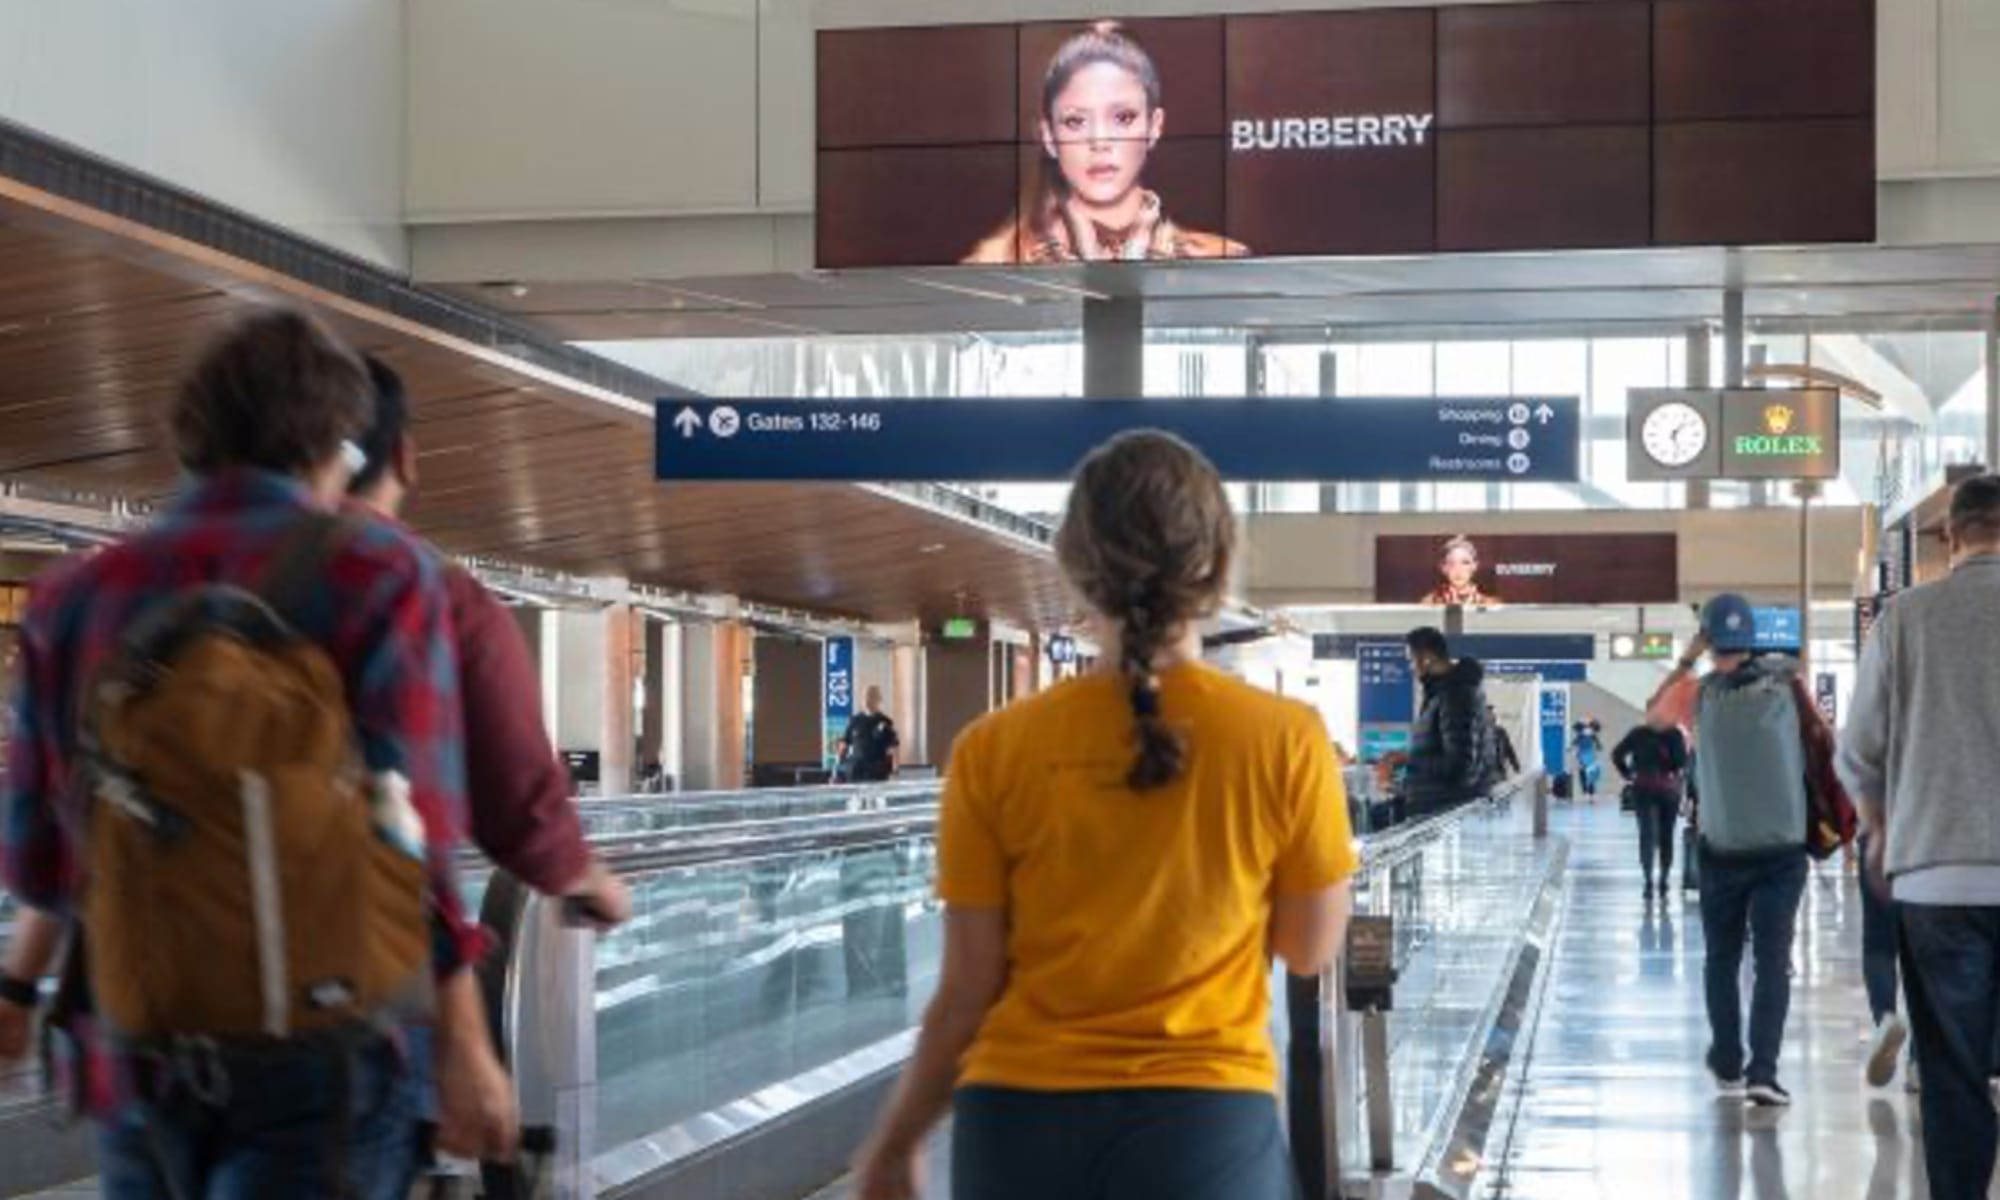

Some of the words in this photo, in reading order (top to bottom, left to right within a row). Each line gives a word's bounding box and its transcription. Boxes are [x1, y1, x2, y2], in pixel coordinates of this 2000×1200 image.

[1231, 113, 1433, 151] BURBERRY
[748, 412, 803, 431] Gates
[810, 412, 881, 431] 132-146
[1438, 406, 1503, 424] Shopping
[1459, 433, 1502, 448] Dining
[1735, 435, 1822, 455] ROLEX
[1429, 456, 1501, 471] Restrooms
[828, 669, 850, 707] 132
